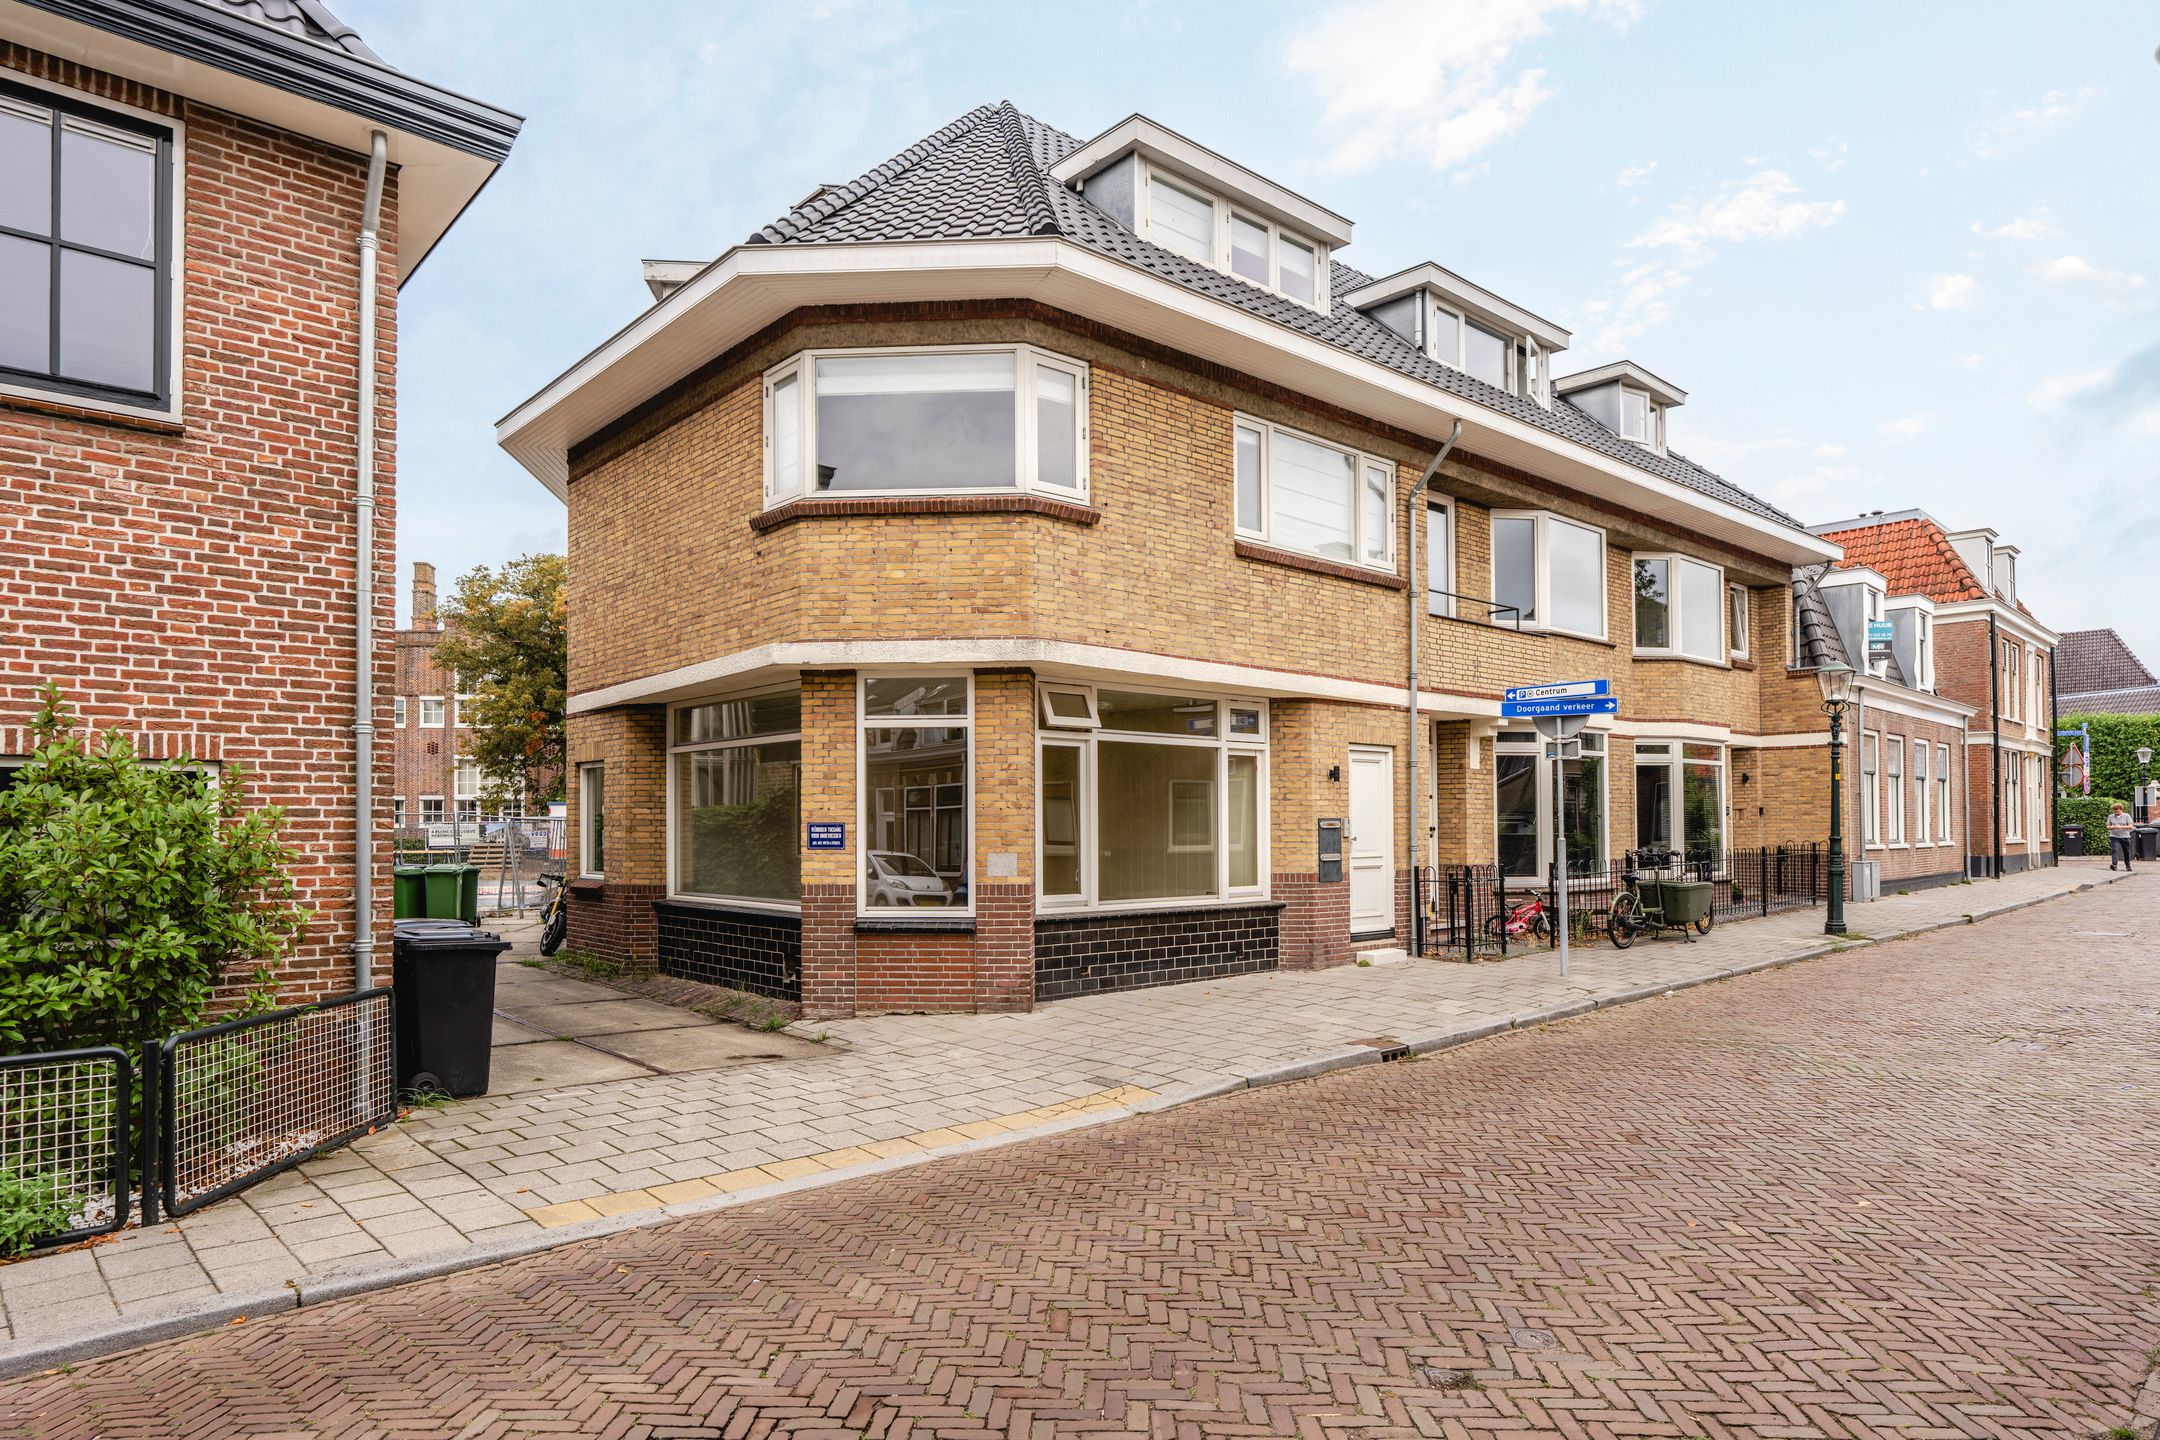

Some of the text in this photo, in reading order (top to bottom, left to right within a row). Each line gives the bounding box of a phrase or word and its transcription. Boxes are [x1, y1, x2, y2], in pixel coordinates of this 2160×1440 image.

[1535, 687, 1568, 696] Centrum
[1516, 703, 1595, 713] Doorgaand verkeer
